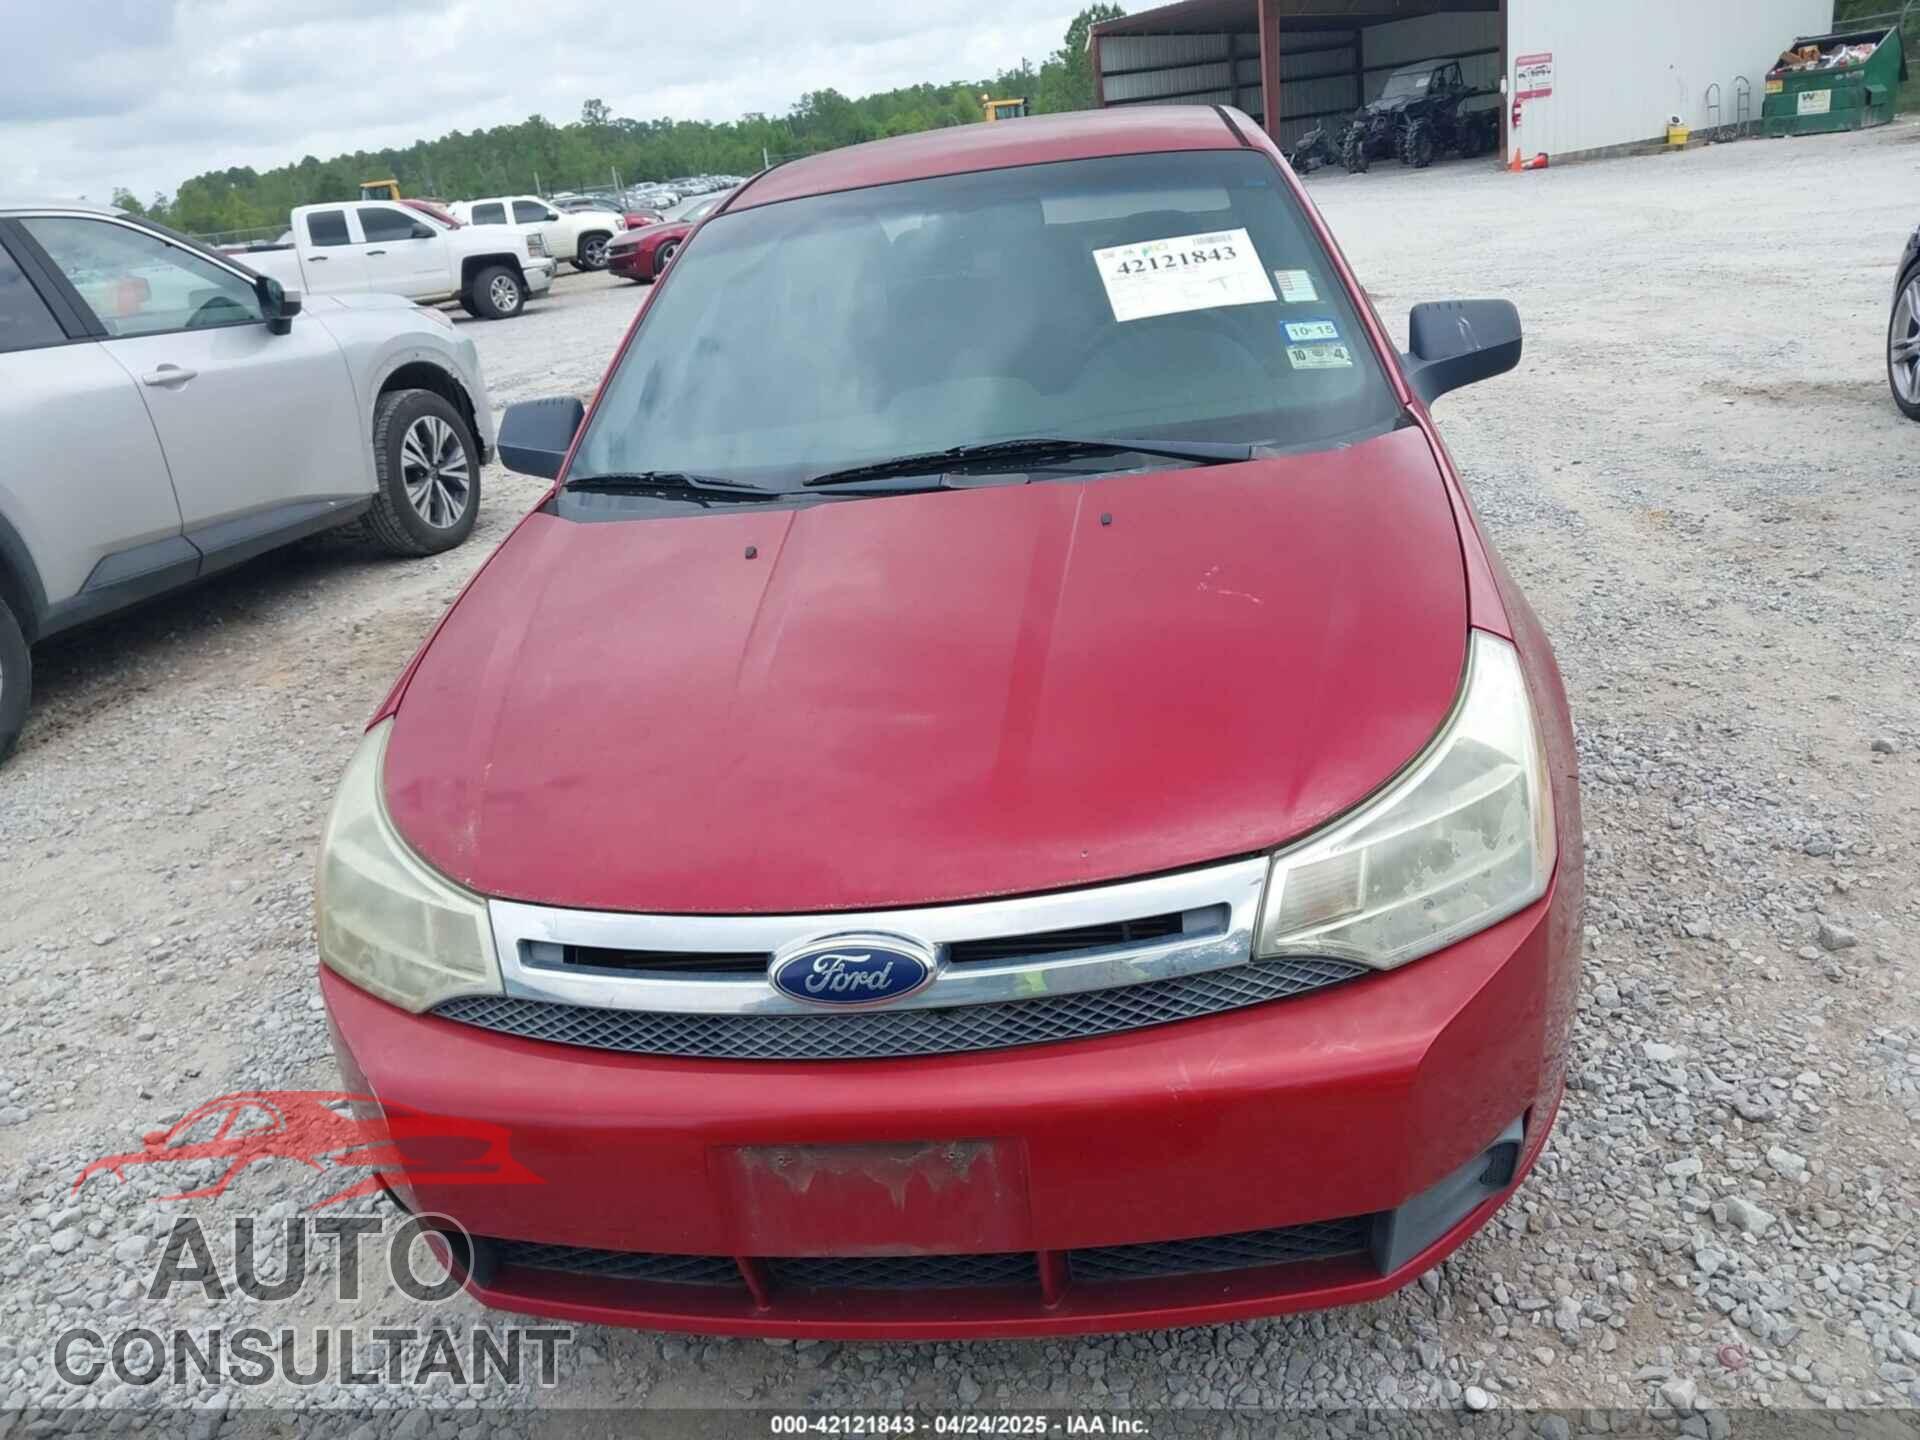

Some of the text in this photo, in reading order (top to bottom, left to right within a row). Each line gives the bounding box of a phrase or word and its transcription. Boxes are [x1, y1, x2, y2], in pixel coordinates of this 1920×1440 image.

[1116, 246, 1237, 275] 42121843
[1292, 349, 1306, 361] 10
[804, 953, 893, 993] Ford
